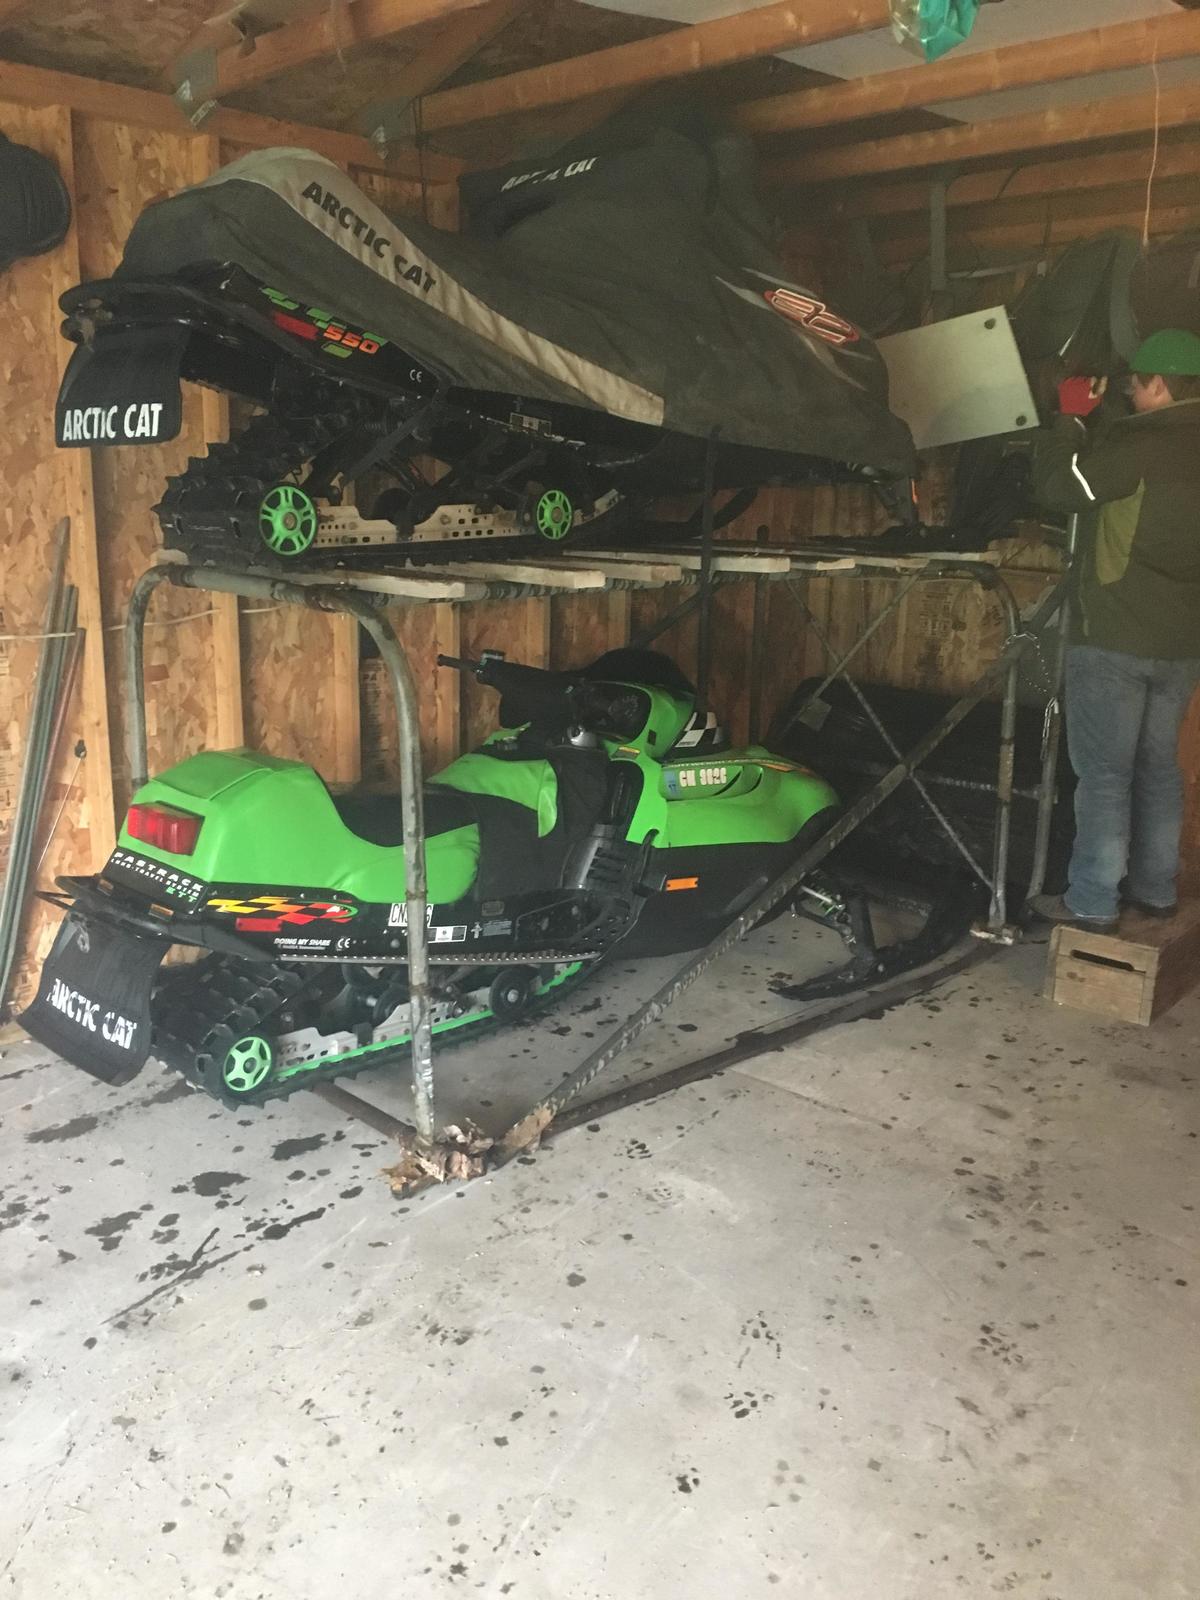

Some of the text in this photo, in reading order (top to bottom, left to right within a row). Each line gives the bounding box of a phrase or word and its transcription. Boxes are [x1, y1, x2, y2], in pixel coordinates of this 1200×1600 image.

[302, 181, 436, 293] ARCTIC CAT
[323, 324, 381, 354] 550
[62, 403, 163, 441] ARCTIC CAT
[113, 852, 204, 892] FASTRACK
[46, 978, 138, 1050] ARCTIC CAT
